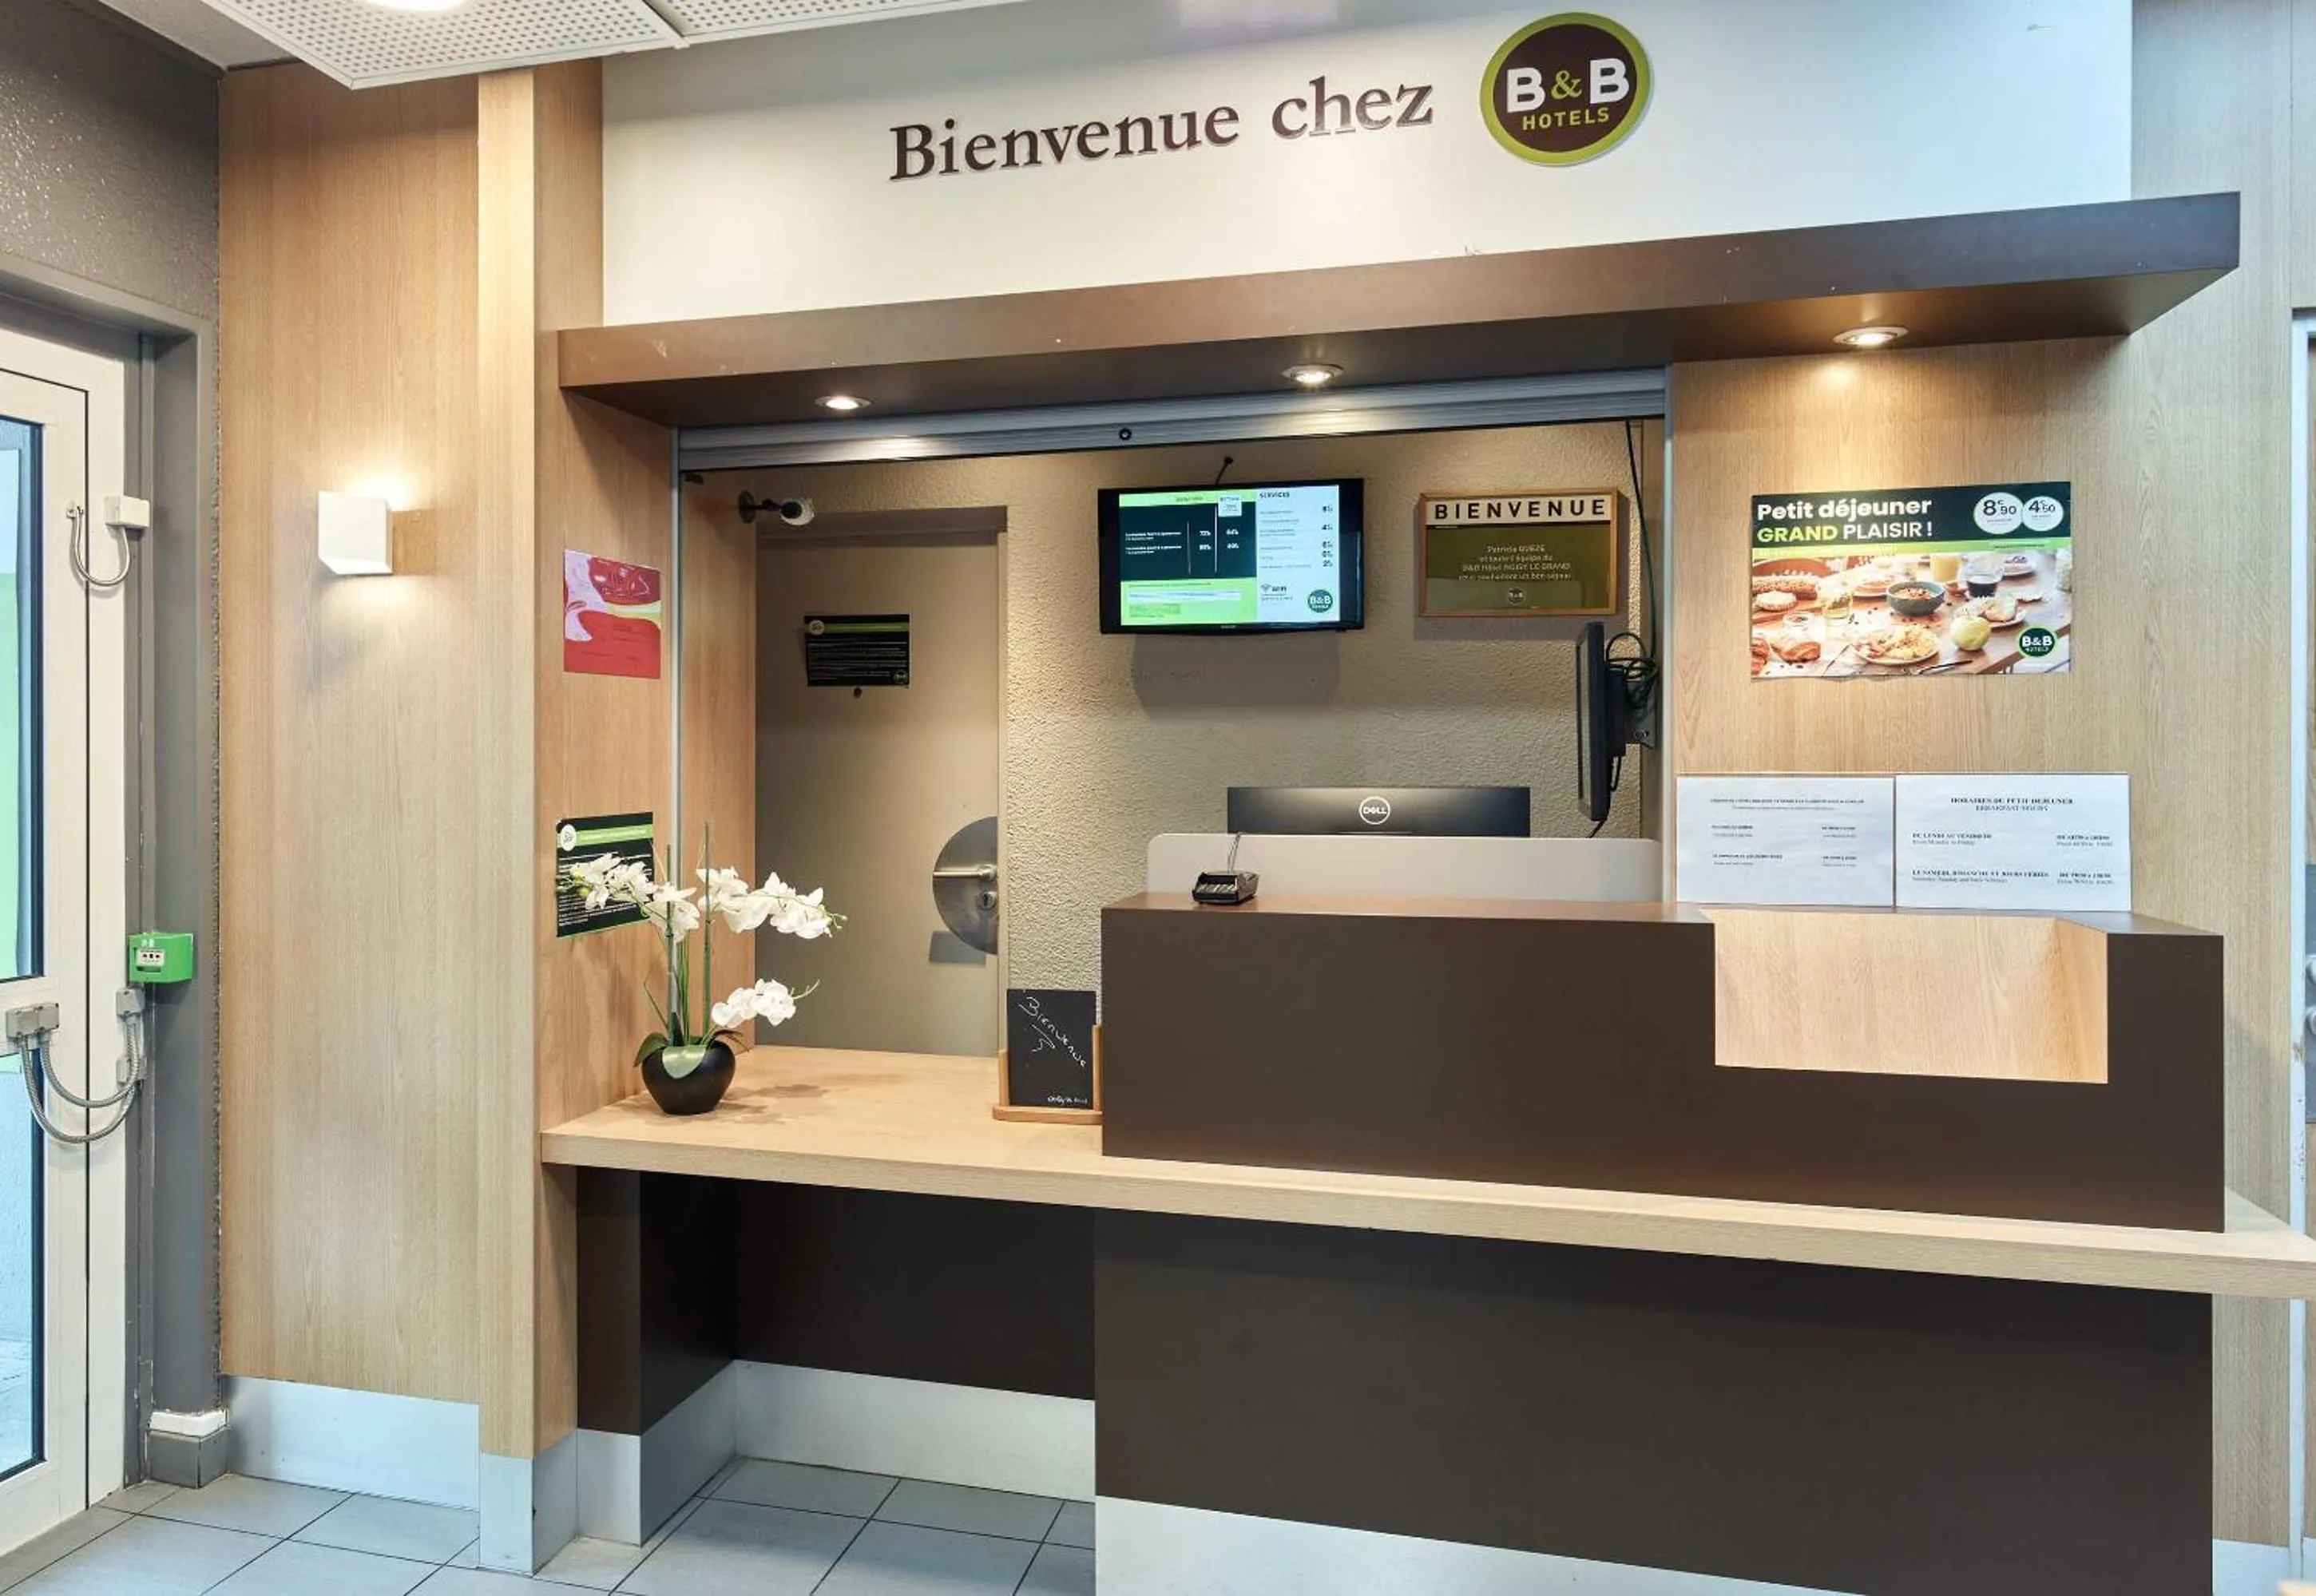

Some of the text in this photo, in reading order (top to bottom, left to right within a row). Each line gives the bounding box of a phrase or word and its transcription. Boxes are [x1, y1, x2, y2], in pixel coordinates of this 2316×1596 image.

[1507, 58, 1630, 113] B&B
[890, 76, 1434, 180] Bienvenue chez
[1522, 107, 1610, 131] HOTELS
[1434, 499, 1605, 520] BIENVENUE
[1758, 498, 1933, 521] Petit déjeuner
[1757, 521, 1933, 542] GRAND PLAISIR !
[2022, 636, 2052, 648] B&B
[1019, 996, 1087, 1068] Bienvenue
